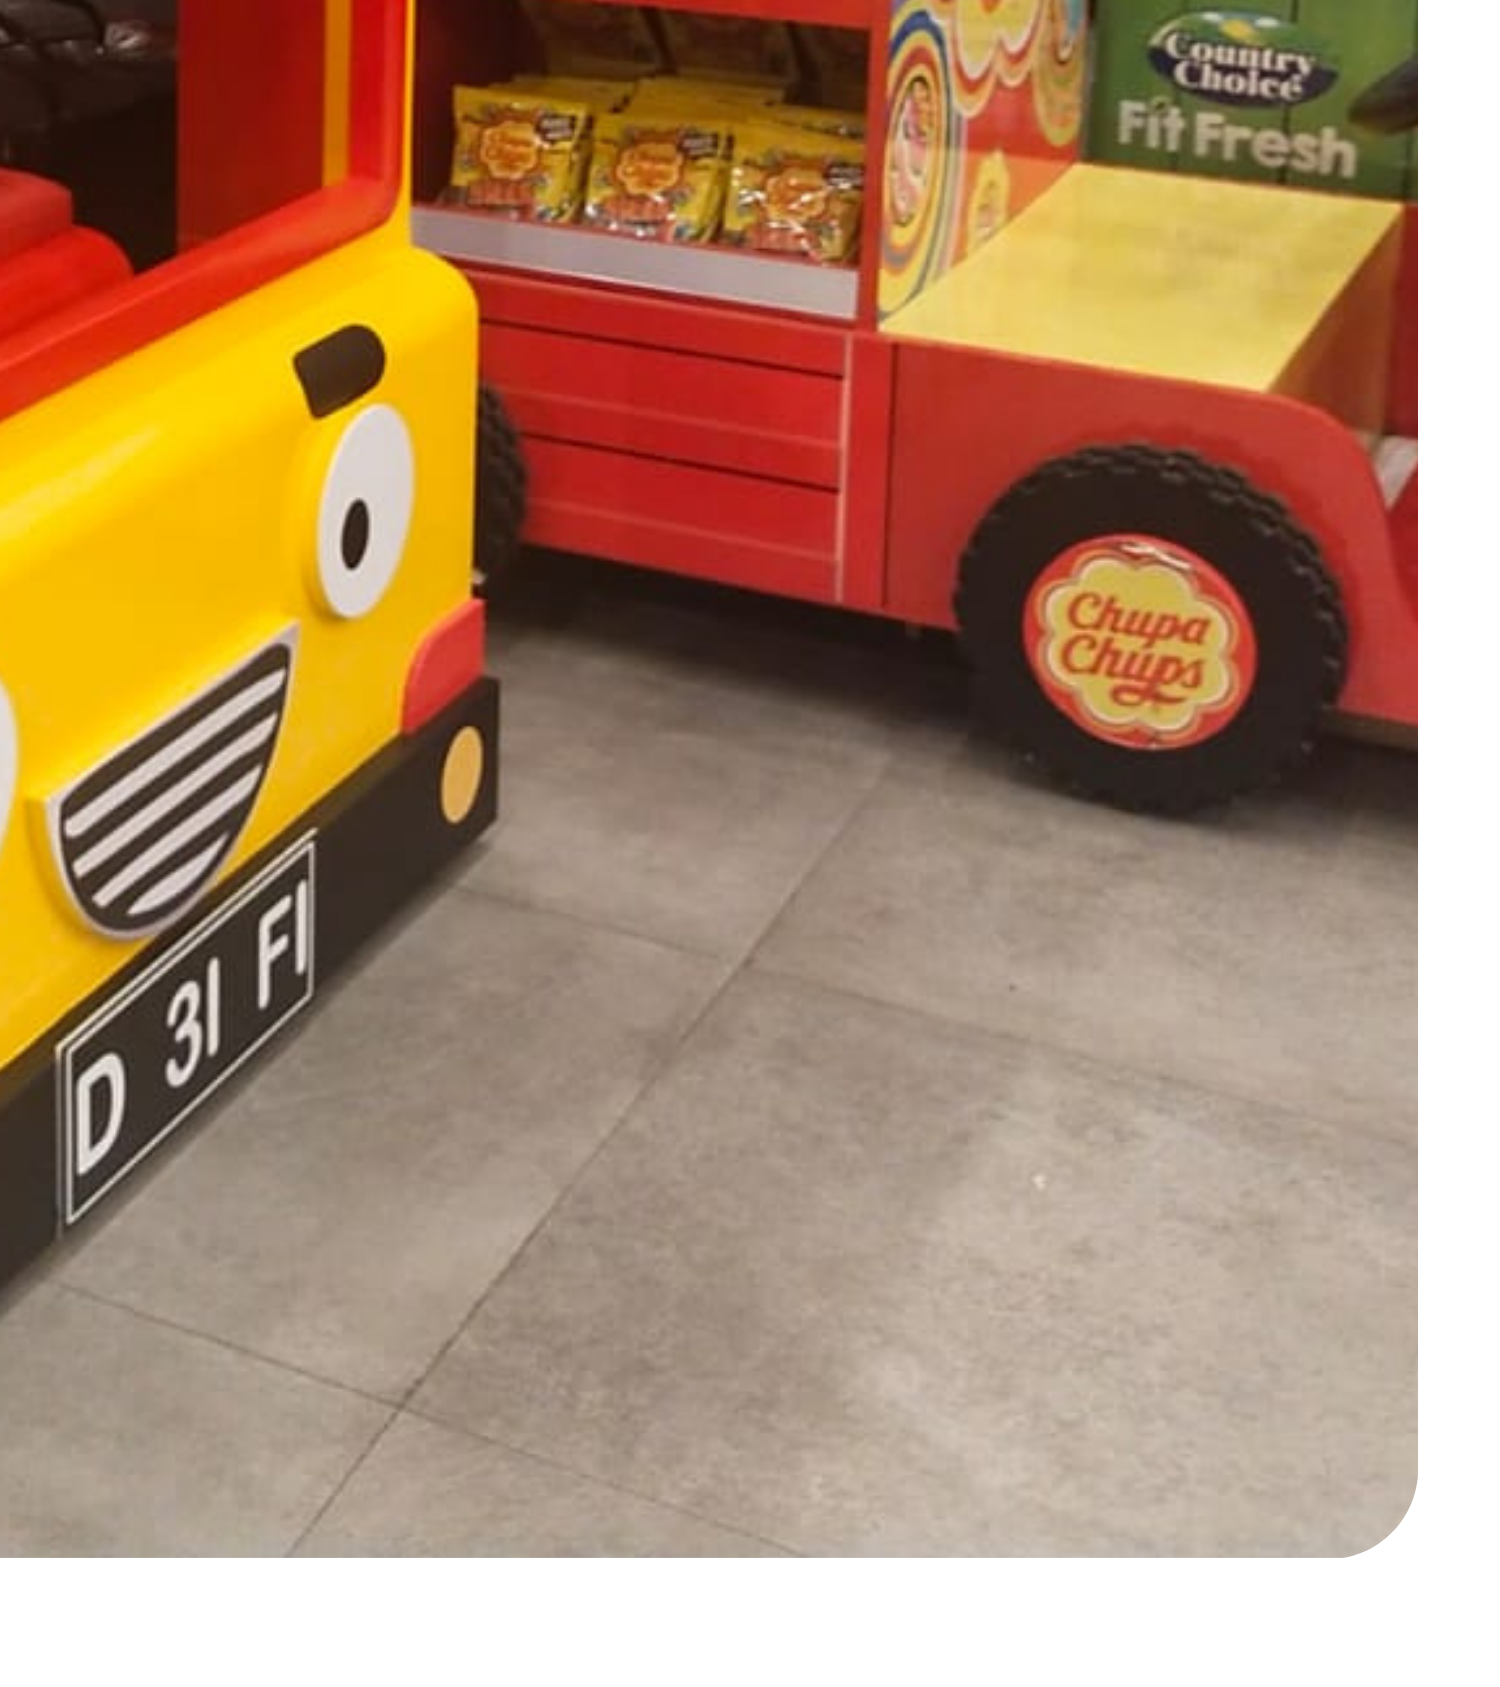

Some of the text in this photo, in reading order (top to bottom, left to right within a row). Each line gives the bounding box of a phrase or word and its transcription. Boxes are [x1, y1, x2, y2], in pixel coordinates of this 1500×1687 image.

[1165, 32, 1316, 76] Country
[1173, 61, 1304, 101] Choice
[1118, 97, 1357, 179] Fit Fresh
[1067, 592, 1211, 646] Chupa
[1061, 634, 1204, 706] Chups
[75, 1052, 126, 1175] D
